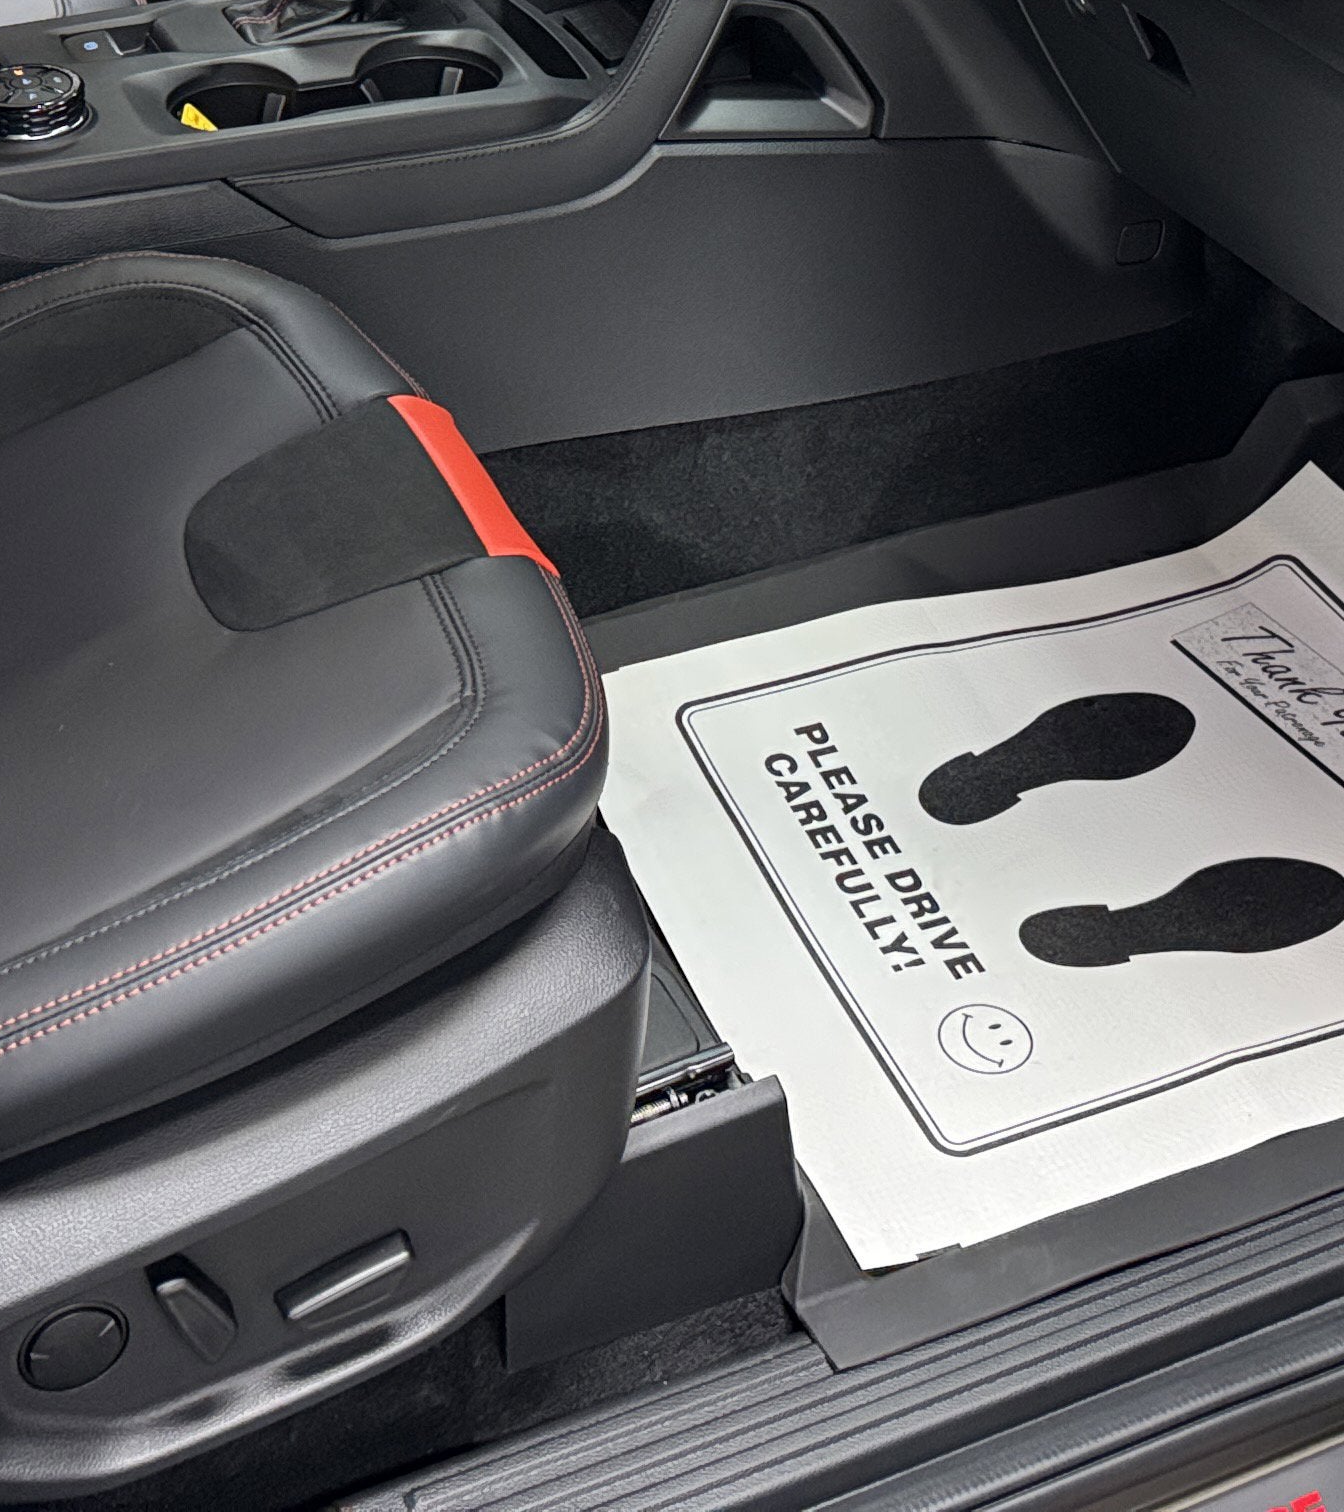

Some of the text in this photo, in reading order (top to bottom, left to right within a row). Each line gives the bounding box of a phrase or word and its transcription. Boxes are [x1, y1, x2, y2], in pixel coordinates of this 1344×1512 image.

[764, 753, 926, 972] CAREFULLY!
[793, 722, 987, 980] PLEASE DRIVE
